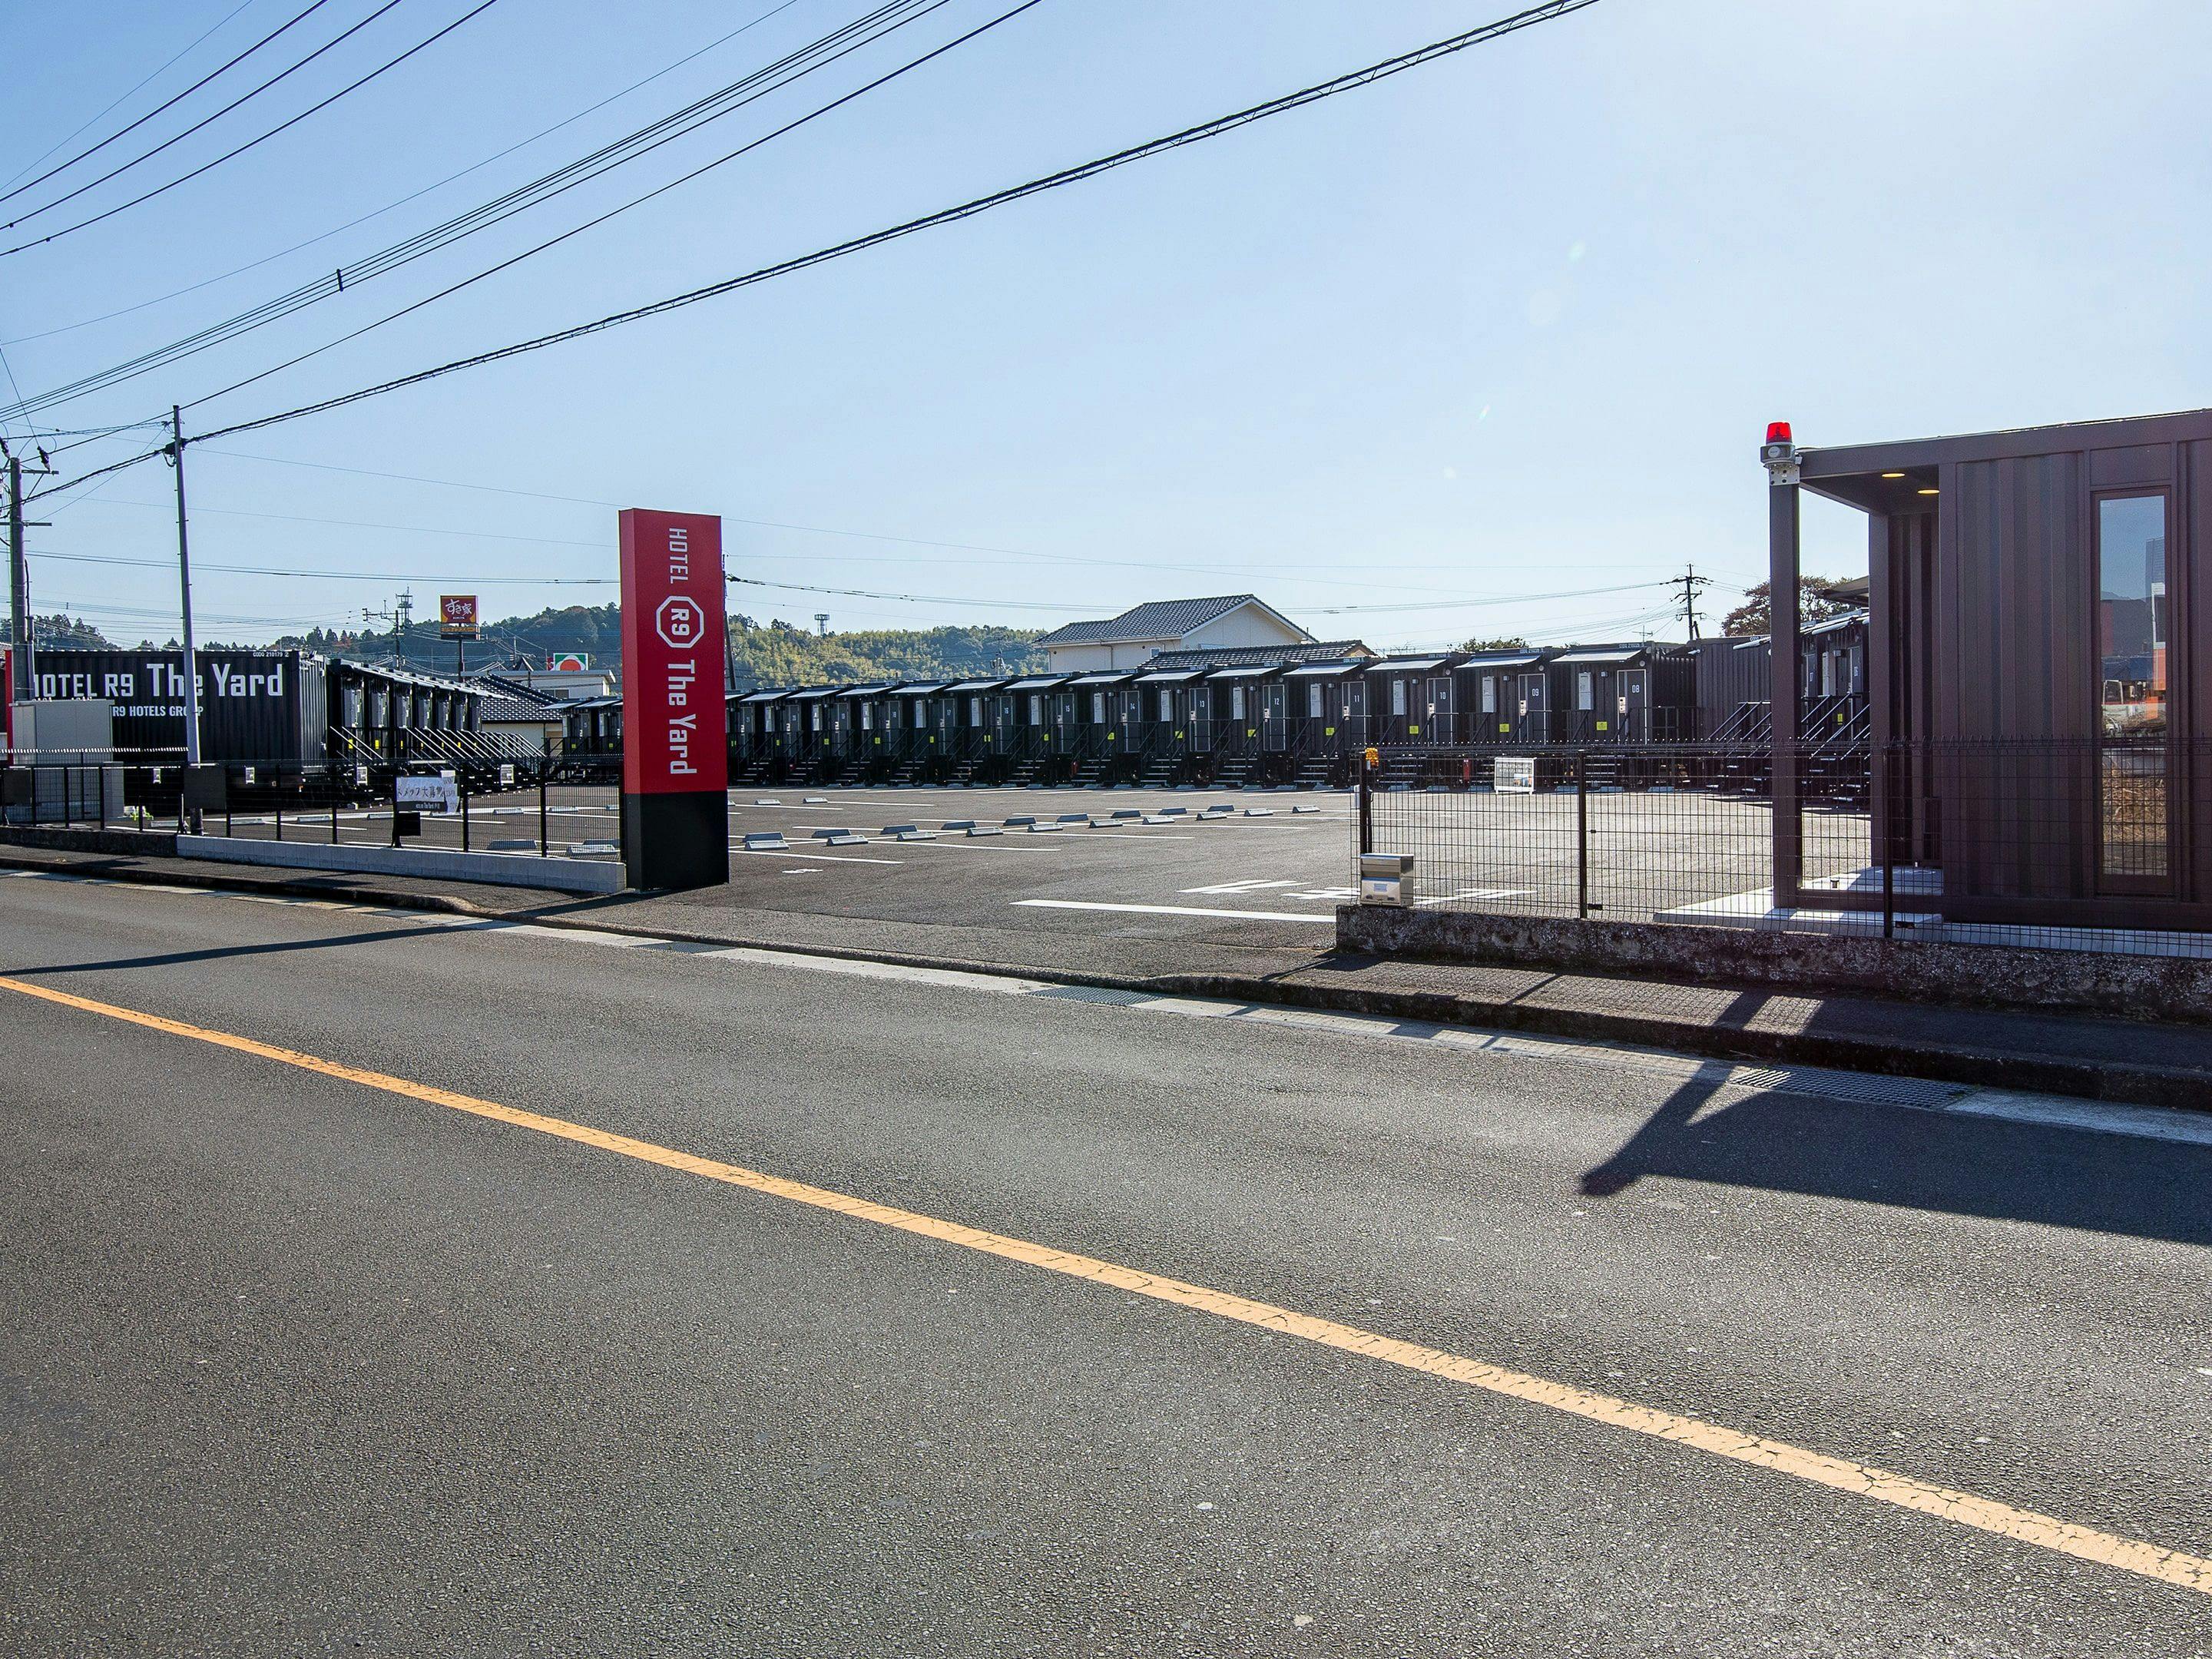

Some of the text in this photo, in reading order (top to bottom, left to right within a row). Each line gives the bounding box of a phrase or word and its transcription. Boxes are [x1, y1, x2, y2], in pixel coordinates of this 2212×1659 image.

[445, 599, 472, 617] すき家
[667, 528, 697, 774] HOTEL R9 The Yard
[104, 674, 134, 697] R9
[211, 663, 283, 697] Yard
[1532, 688, 1539, 697] 09
[1631, 684, 1640, 694] 08
[1354, 694, 1359, 703] 11
[1439, 691, 1446, 700] 10
[129, 705, 166, 717] HOTELS
[169, 705, 204, 717] GRP
